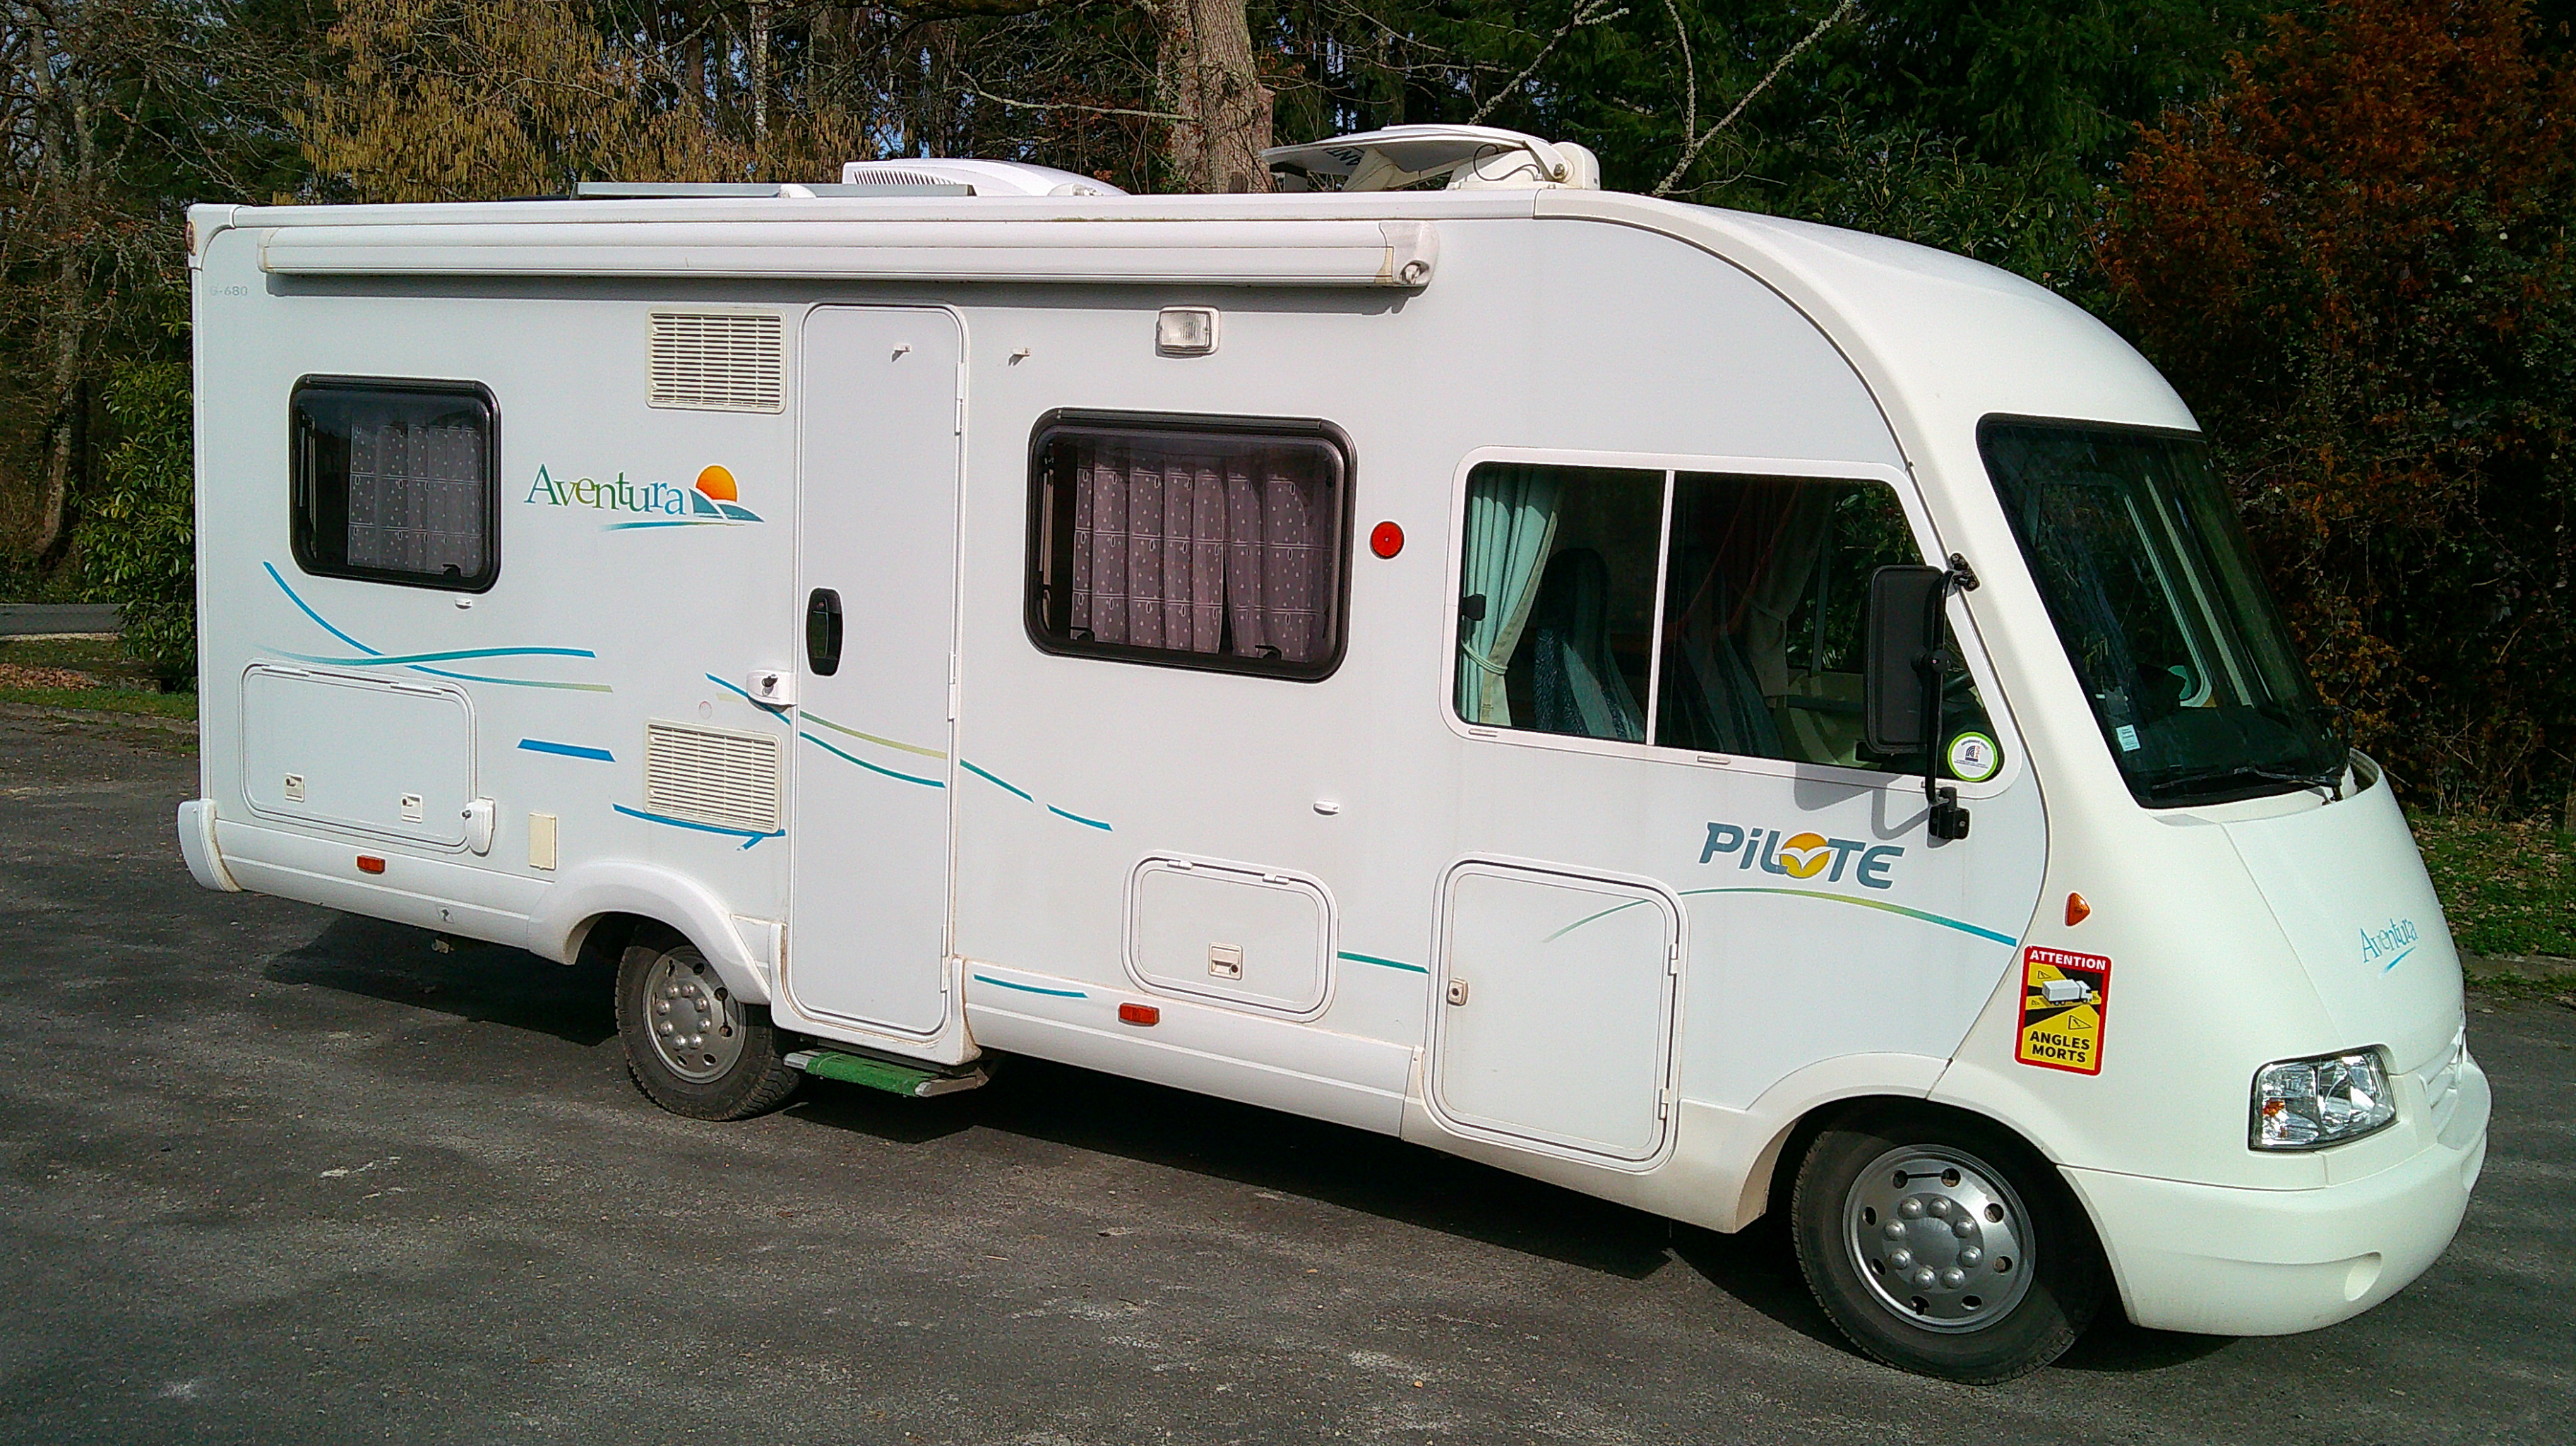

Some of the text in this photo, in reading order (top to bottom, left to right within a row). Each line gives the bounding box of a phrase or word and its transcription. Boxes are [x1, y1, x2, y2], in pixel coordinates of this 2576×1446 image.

[524, 463, 686, 515] Aventura
[2360, 918, 2419, 963] Aventura
[2029, 950, 2106, 971] ATTENTION
[2029, 1030, 2090, 1050] ANGLES
[2032, 1044, 2086, 1063] MORTS
